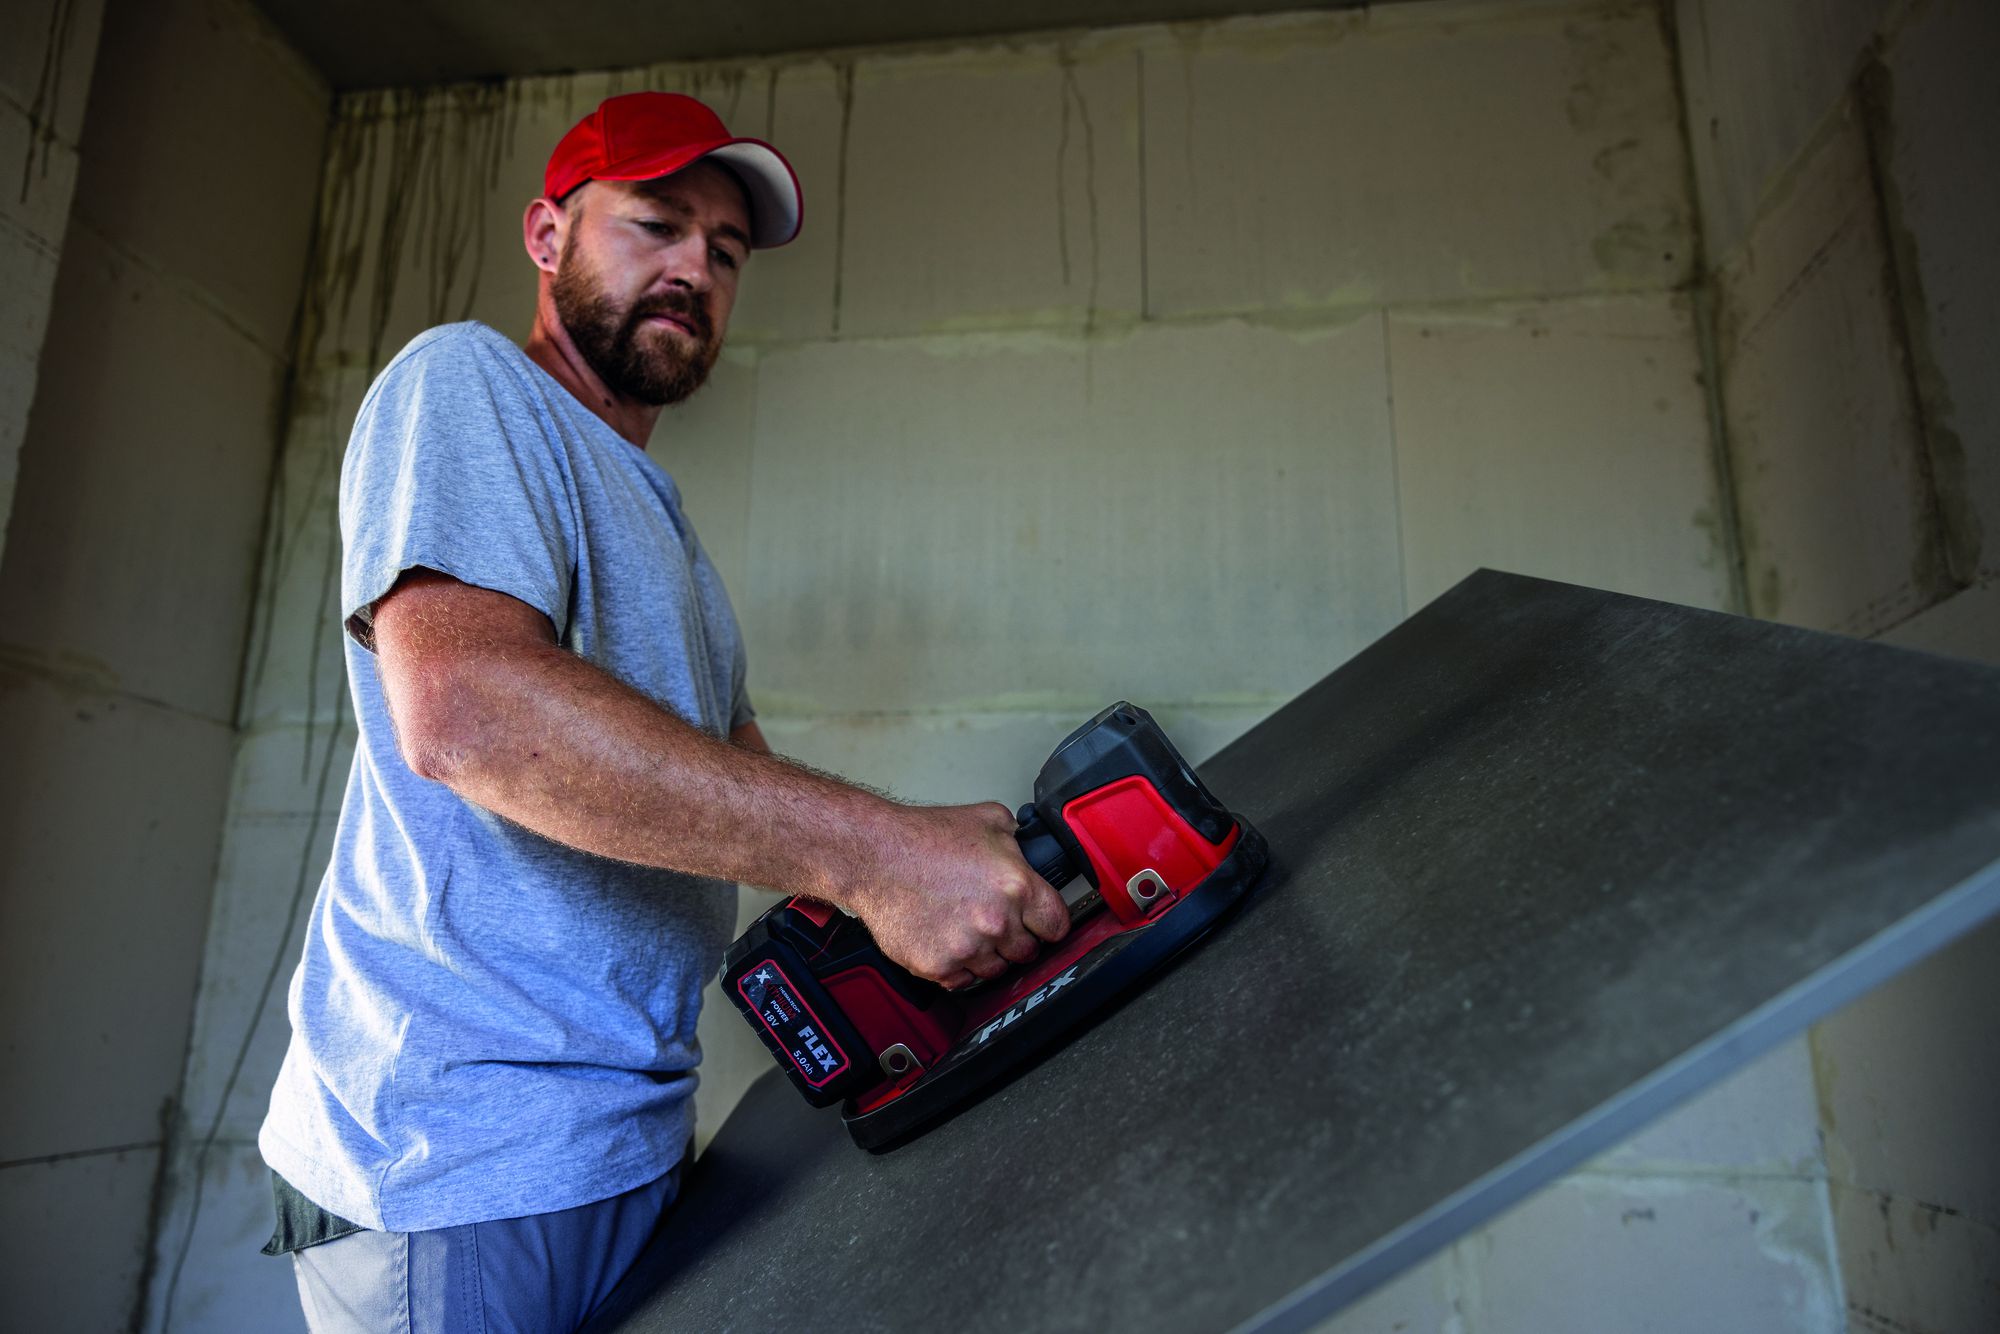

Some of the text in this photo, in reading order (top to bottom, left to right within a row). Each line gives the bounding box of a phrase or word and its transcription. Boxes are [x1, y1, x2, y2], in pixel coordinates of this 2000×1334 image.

[755, 968, 771, 984] X
[771, 999, 789, 1022] POWER
[979, 965, 1078, 1044] FLEX
[763, 1009, 780, 1027] 18V
[797, 1025, 838, 1072] FLEX
[793, 1049, 814, 1074] 5.0Ah
